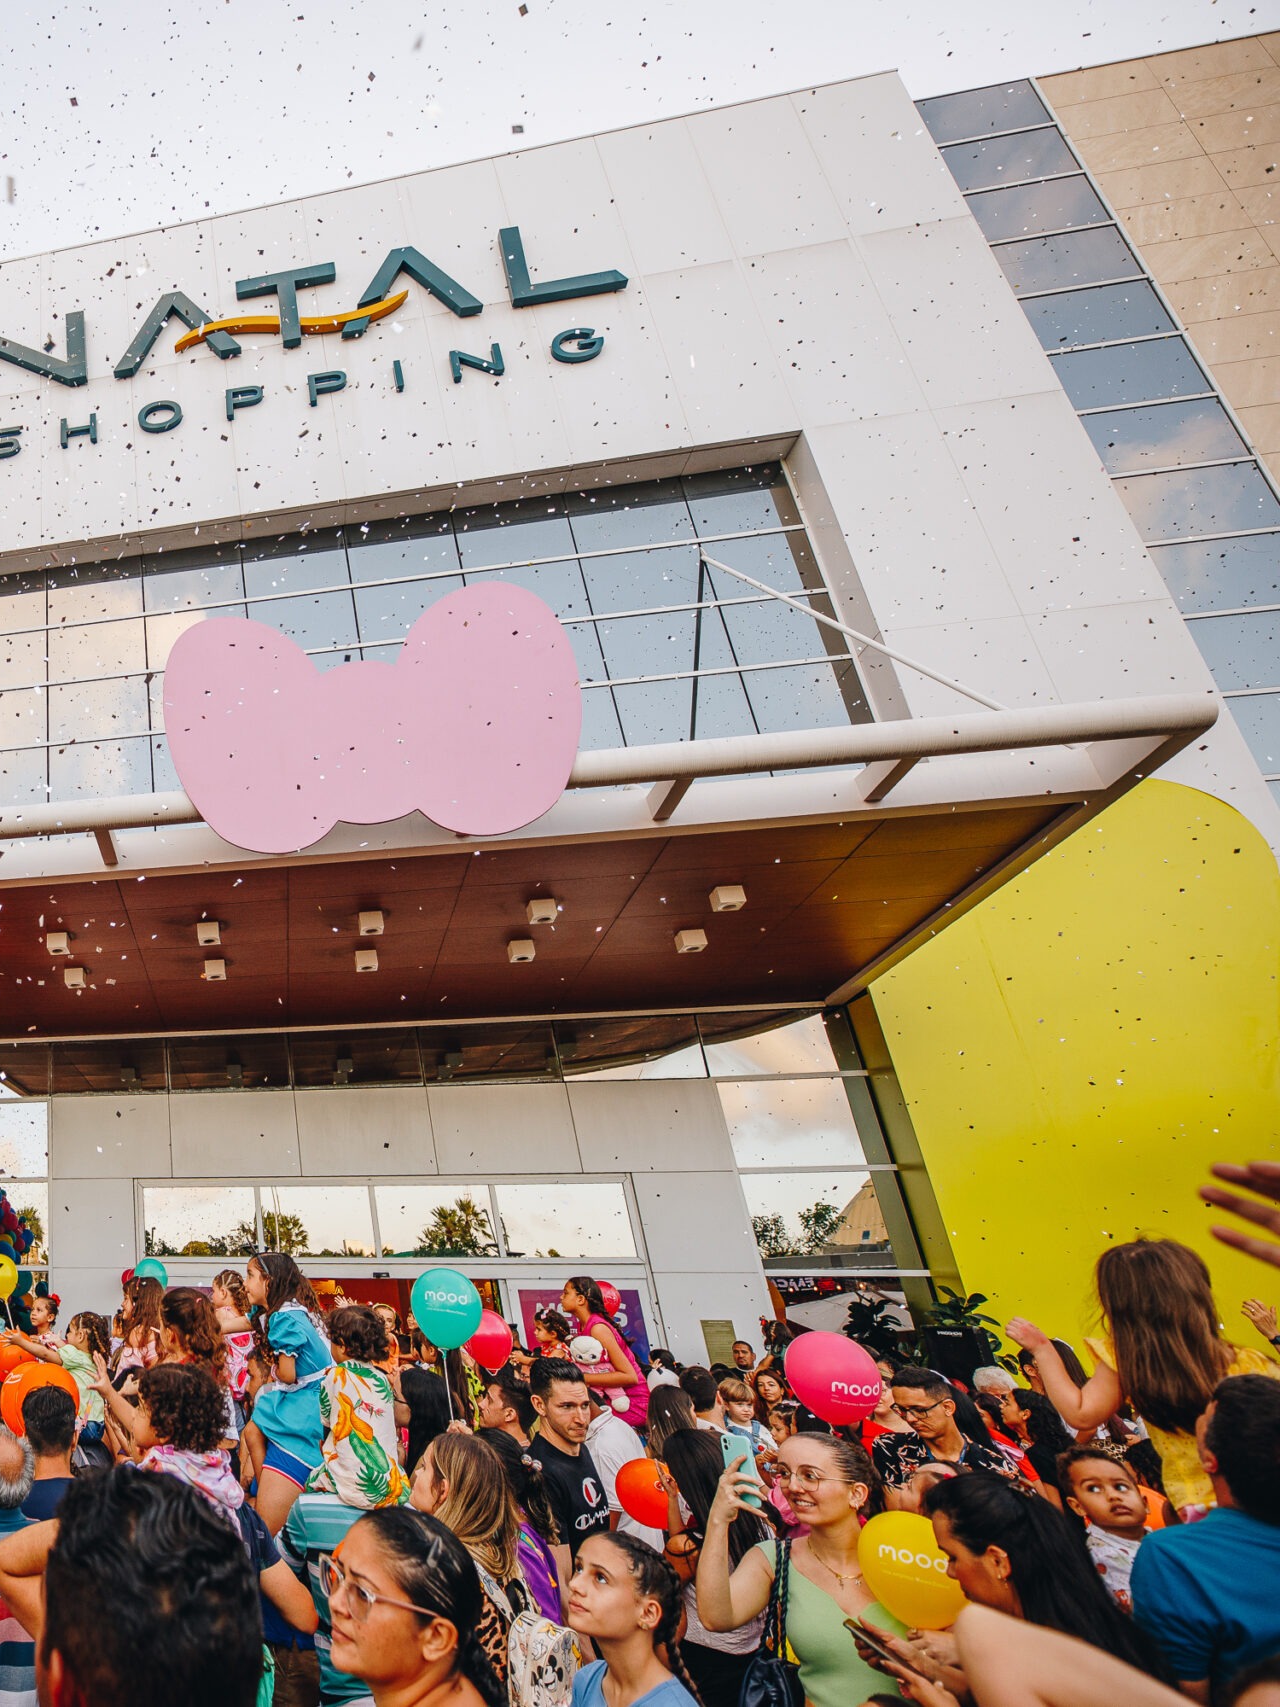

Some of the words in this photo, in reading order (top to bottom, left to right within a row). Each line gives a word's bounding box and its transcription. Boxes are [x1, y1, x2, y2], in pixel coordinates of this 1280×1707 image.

[424, 1290, 468, 1306] mood
[831, 1381, 880, 1397] mood
[878, 1544, 949, 1573] mood
